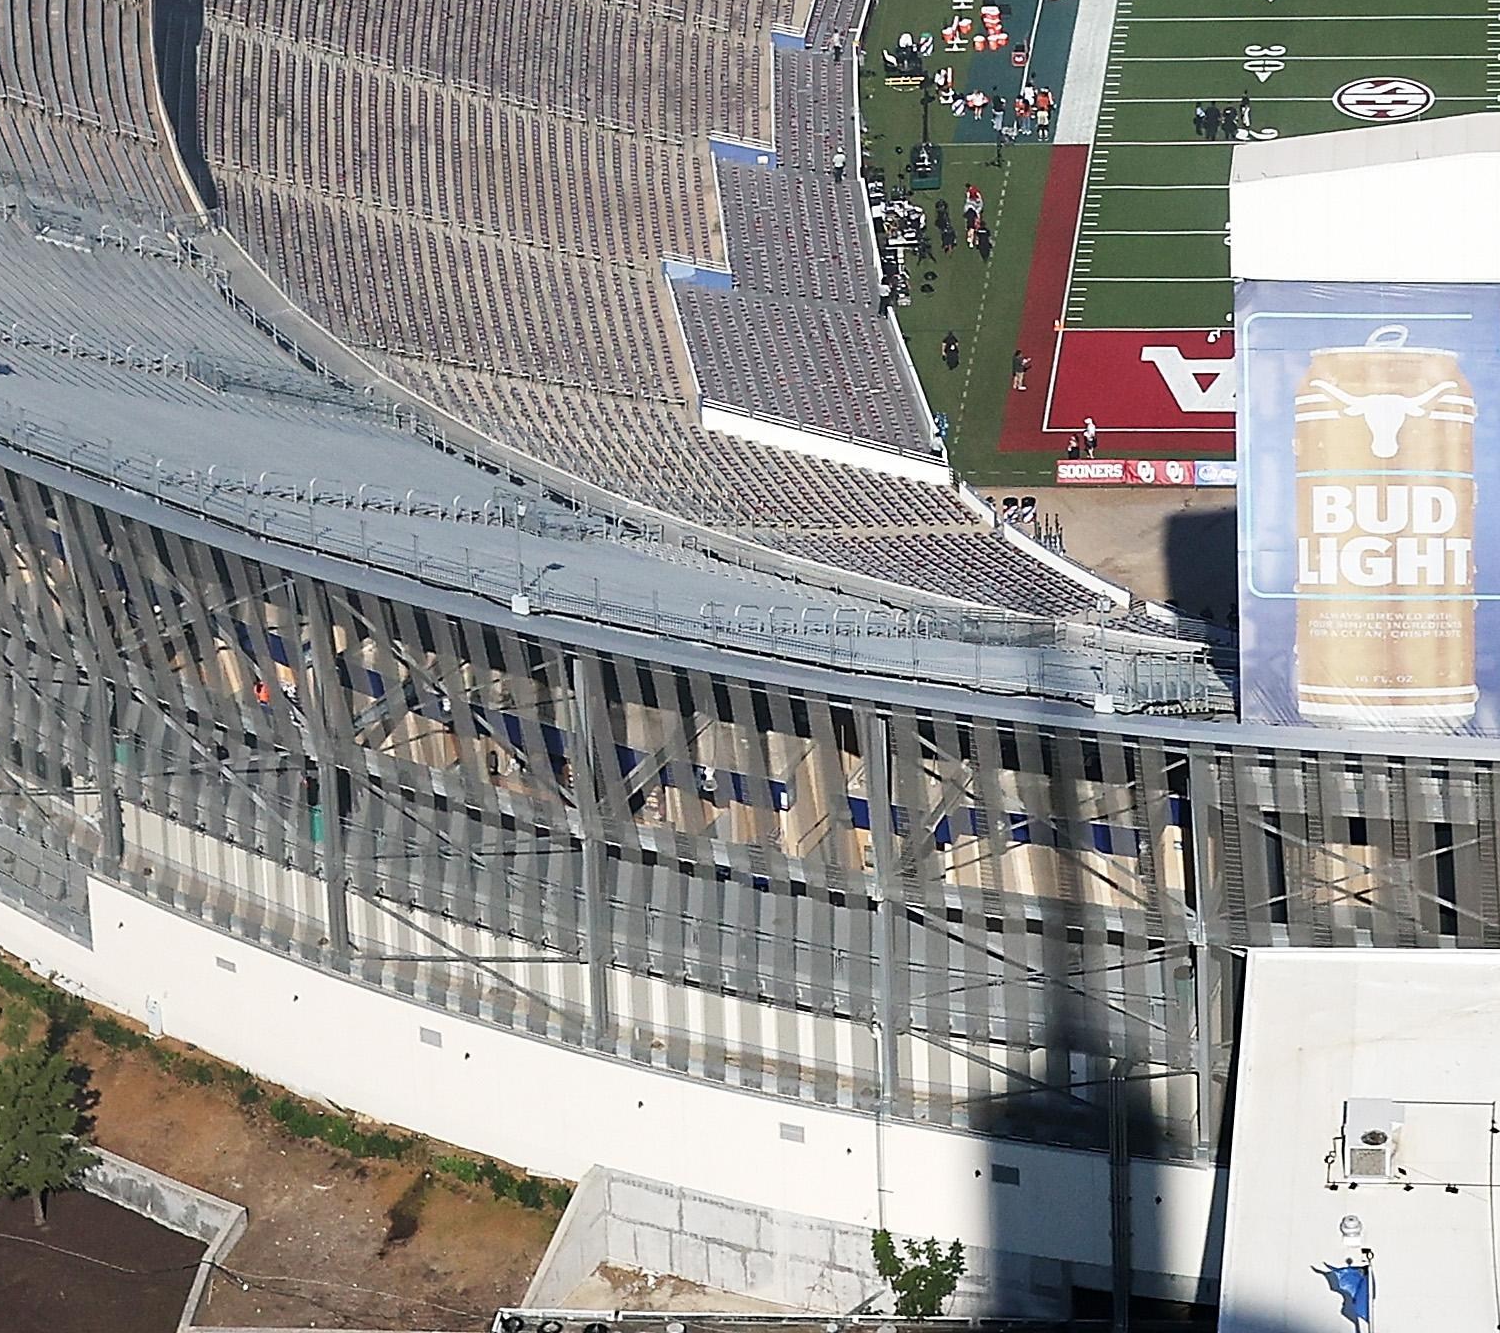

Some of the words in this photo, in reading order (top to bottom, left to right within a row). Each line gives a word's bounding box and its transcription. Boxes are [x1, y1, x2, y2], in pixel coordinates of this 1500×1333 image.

[1244, 45, 1286, 72] 30
[1058, 463, 1123, 479] SOONERS
[1137, 461, 1155, 483] OU
[1166, 461, 1184, 483] OU
[1312, 484, 1457, 534] BUD
[1298, 536, 1471, 587] LIGHT
[1319, 612, 1364, 621] ALWAYS
[1366, 612, 1423, 621] BREWED
[1336, 620, 1383, 630] SIMPLE
[1387, 620, 1462, 630] INGREDIENTS
[1340, 629, 1386, 639] CLEAN,
[1390, 630, 1431, 639] CRISP
[1355, 675, 1368, 683] 16
[1396, 675, 1418, 683] OZ.
